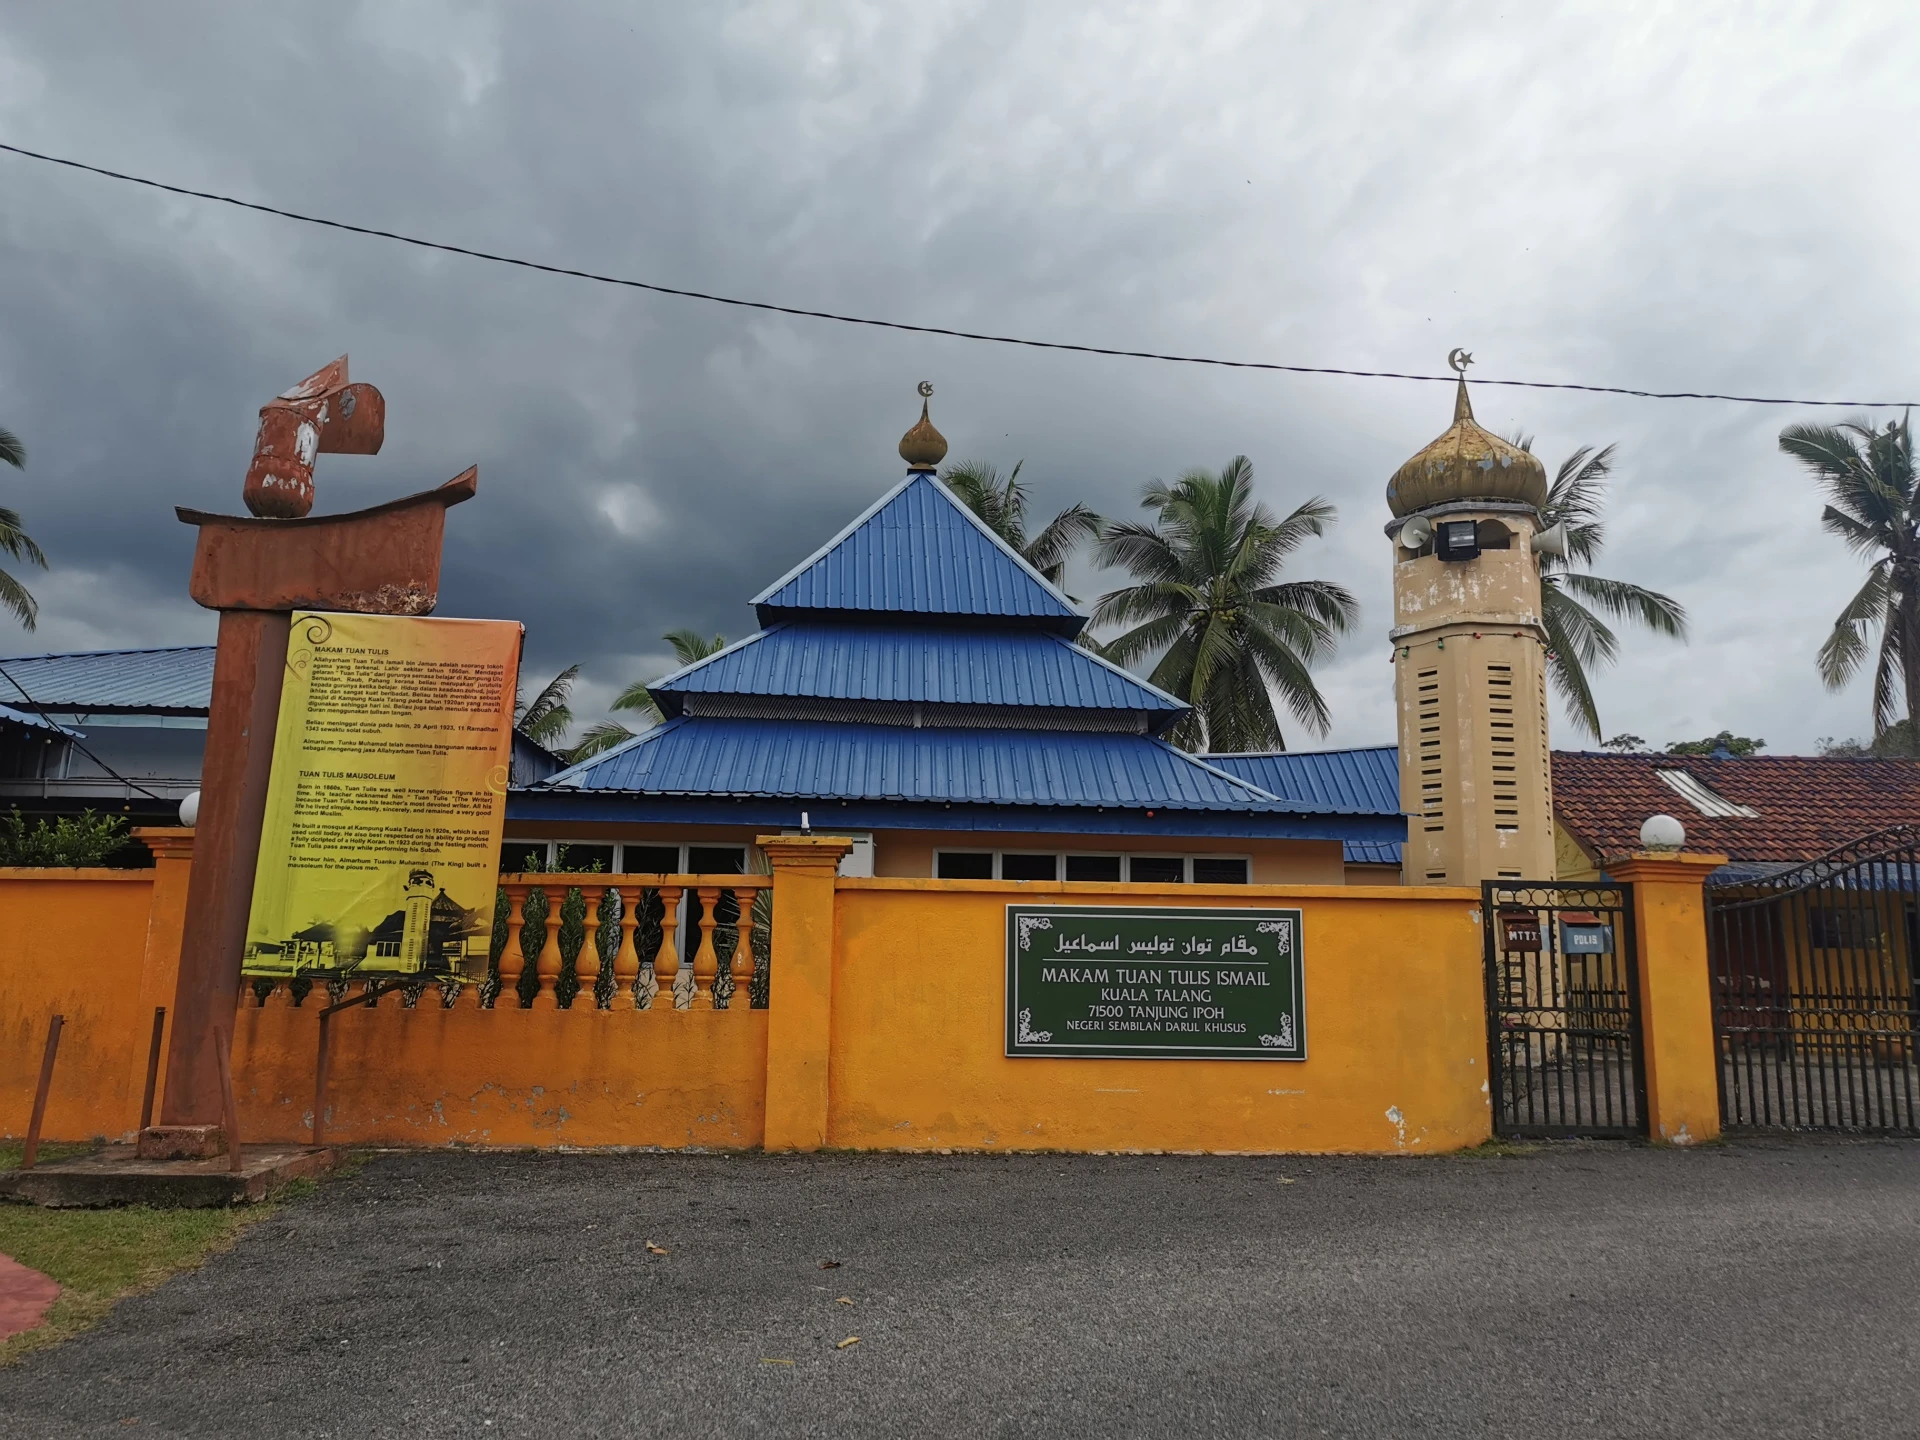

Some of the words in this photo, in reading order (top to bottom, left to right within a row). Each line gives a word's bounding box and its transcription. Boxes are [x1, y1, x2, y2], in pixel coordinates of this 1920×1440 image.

[445, 841, 467, 849] fasting
[1053, 933, 1119, 954] اسماعيل
[1126, 934, 1175, 955] توليس
[1181, 935, 1213, 956] توان
[1219, 934, 1258, 957] مقام
[1574, 935, 1598, 945] POLIS
[1041, 968, 1110, 984] MAKAM
[1115, 970, 1162, 985] TUAN
[1167, 970, 1211, 985] TULIS
[1216, 971, 1271, 986] ISMAIL
[1101, 989, 1149, 1002] KUALA
[1154, 989, 1212, 1003] TALANG
[1088, 1005, 1124, 1018] 71500
[1128, 1006, 1188, 1022] TANJUNG
[1193, 1007, 1225, 1020] IPOH
[1066, 1021, 1104, 1031] NEGERI
[1108, 1021, 1161, 1032] SEMBILAN
[1165, 1022, 1200, 1032] DARUL
[1204, 1023, 1247, 1033] KHUSUS
